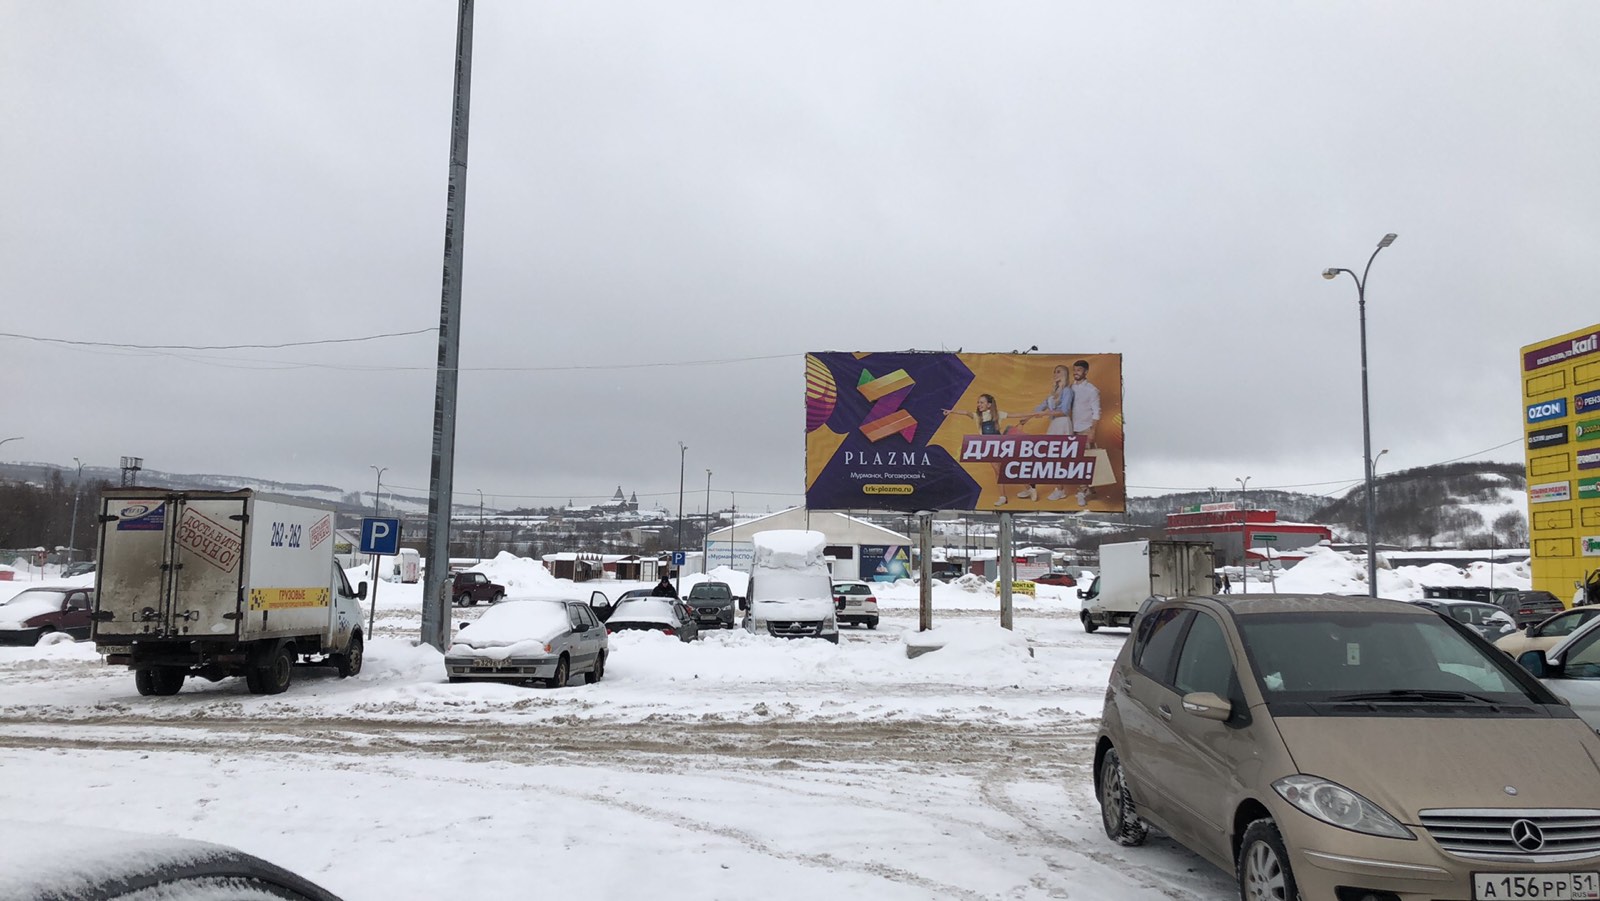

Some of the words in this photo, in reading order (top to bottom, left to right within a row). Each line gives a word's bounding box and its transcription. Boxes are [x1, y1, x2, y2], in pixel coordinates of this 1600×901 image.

[1572, 334, 1598, 356] kari
[1528, 402, 1561, 419] OZON
[962, 440, 1016, 460] ДЛЯ
[1019, 436, 1079, 459] ВСЕЙ
[844, 451, 932, 466] PLAZMA
[850, 472, 883, 480] Мурманск,
[1004, 461, 1093, 480] СЕМЬИ!
[183, 515, 241, 554] ДОСТАВИТЬ
[371, 522, 389, 549] P
[176, 525, 236, 567] СРОЧНО!
[279, 590, 306, 601] ГРУЗОВЫЕ
[1573, 875, 1593, 891] 51
